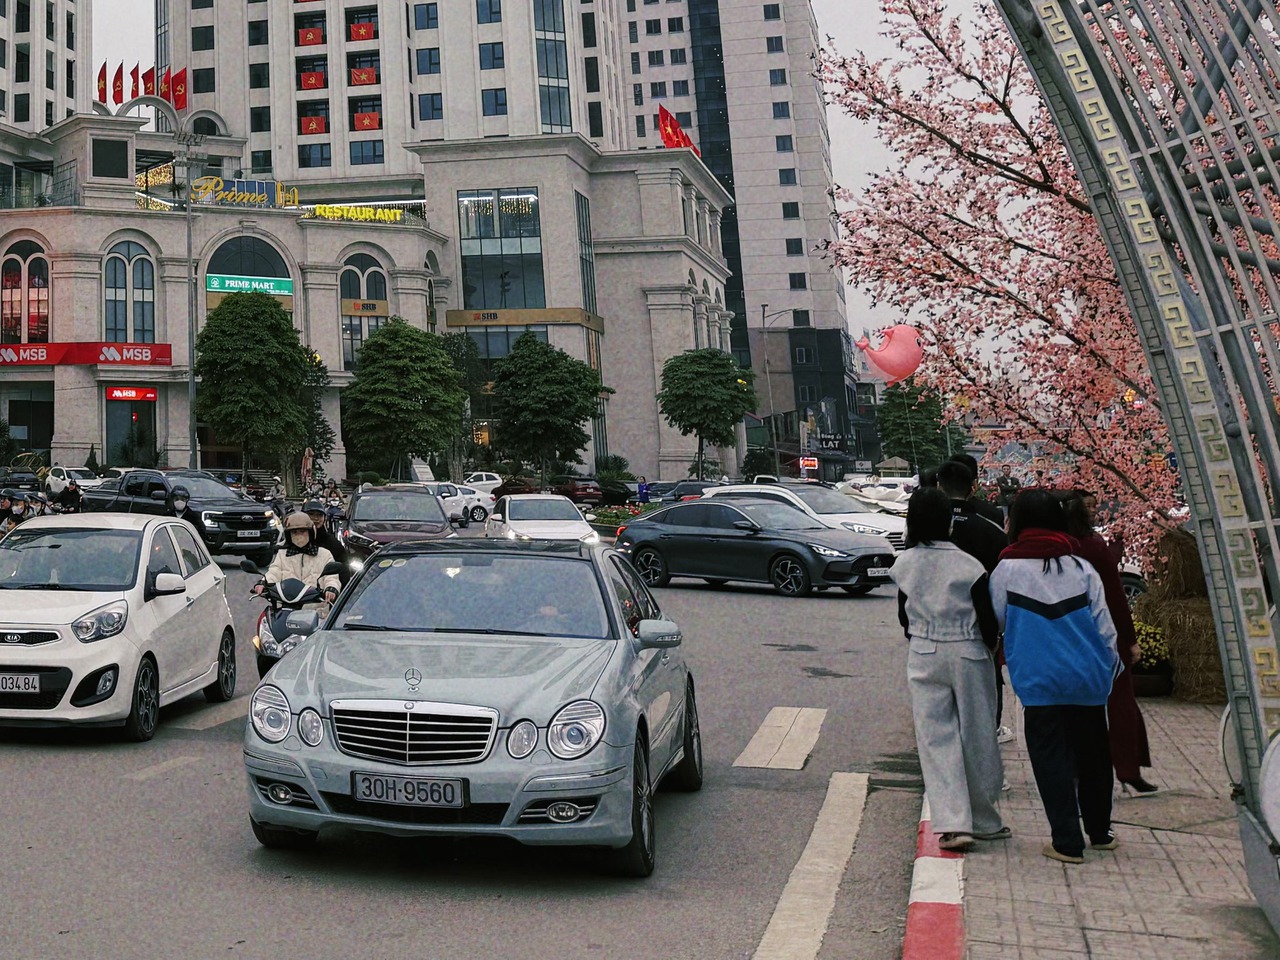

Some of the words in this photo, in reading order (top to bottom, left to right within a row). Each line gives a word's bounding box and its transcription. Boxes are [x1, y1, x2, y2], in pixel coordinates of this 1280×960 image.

[190, 176, 268, 203] Prime
[315, 204, 402, 221] RESTAURANT
[225, 280, 251, 289] PRIME
[251, 281, 275, 290] MART
[19, 348, 47, 361] MSB
[122, 348, 152, 361] MSB
[122, 390, 136, 398] MSB
[361, 777, 455, 804] 30H-9560
